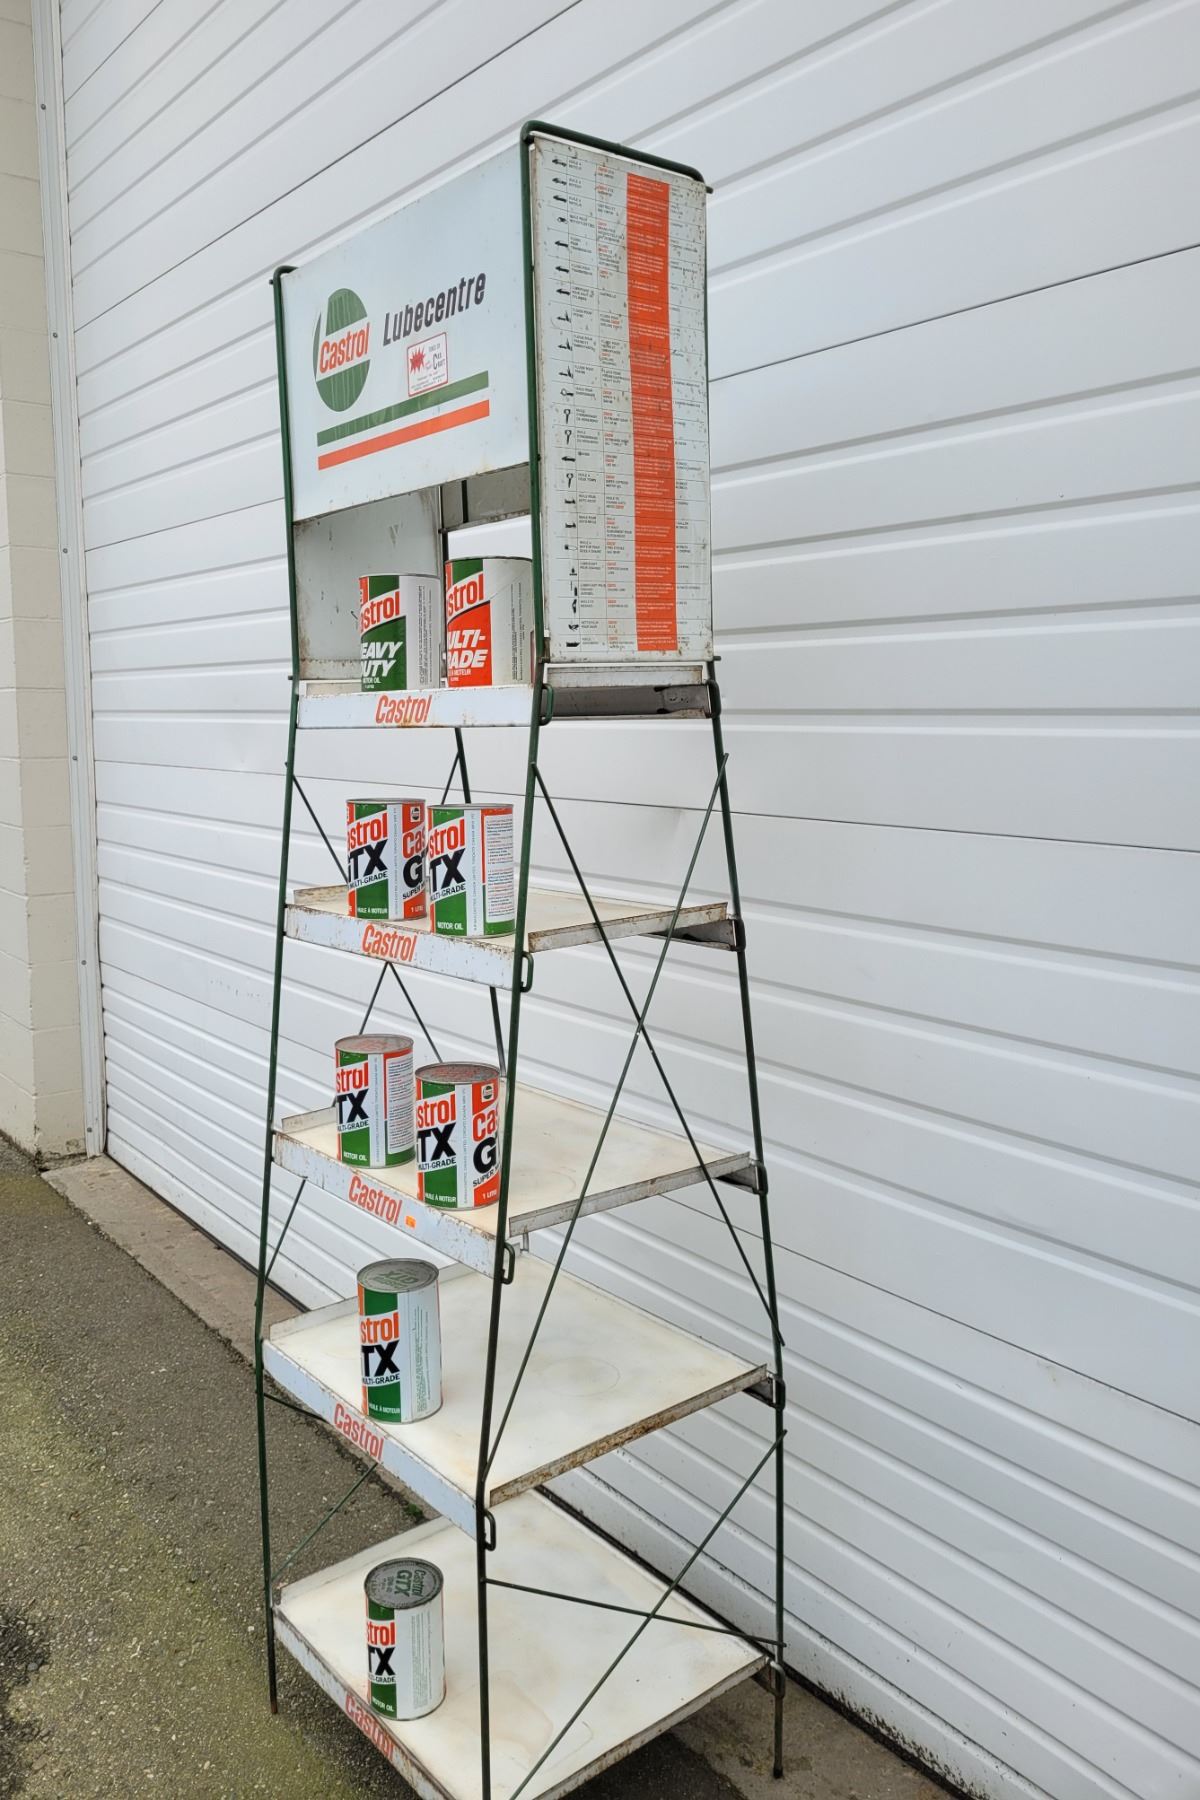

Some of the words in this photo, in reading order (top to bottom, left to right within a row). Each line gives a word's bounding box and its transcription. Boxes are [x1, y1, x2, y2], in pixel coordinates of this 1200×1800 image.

[383, 273, 486, 346] Lubecentre
[319, 322, 370, 373] Castrol
[361, 659, 397, 677] UTY
[375, 695, 432, 724] Castrol
[349, 838, 388, 881] TX
[362, 923, 418, 962] Castrol
[473, 1107, 498, 1142] Ca
[348, 1175, 402, 1226] Castrol
[333, 1403, 385, 1462] Castrol
[345, 1695, 395, 1763] Castrol
